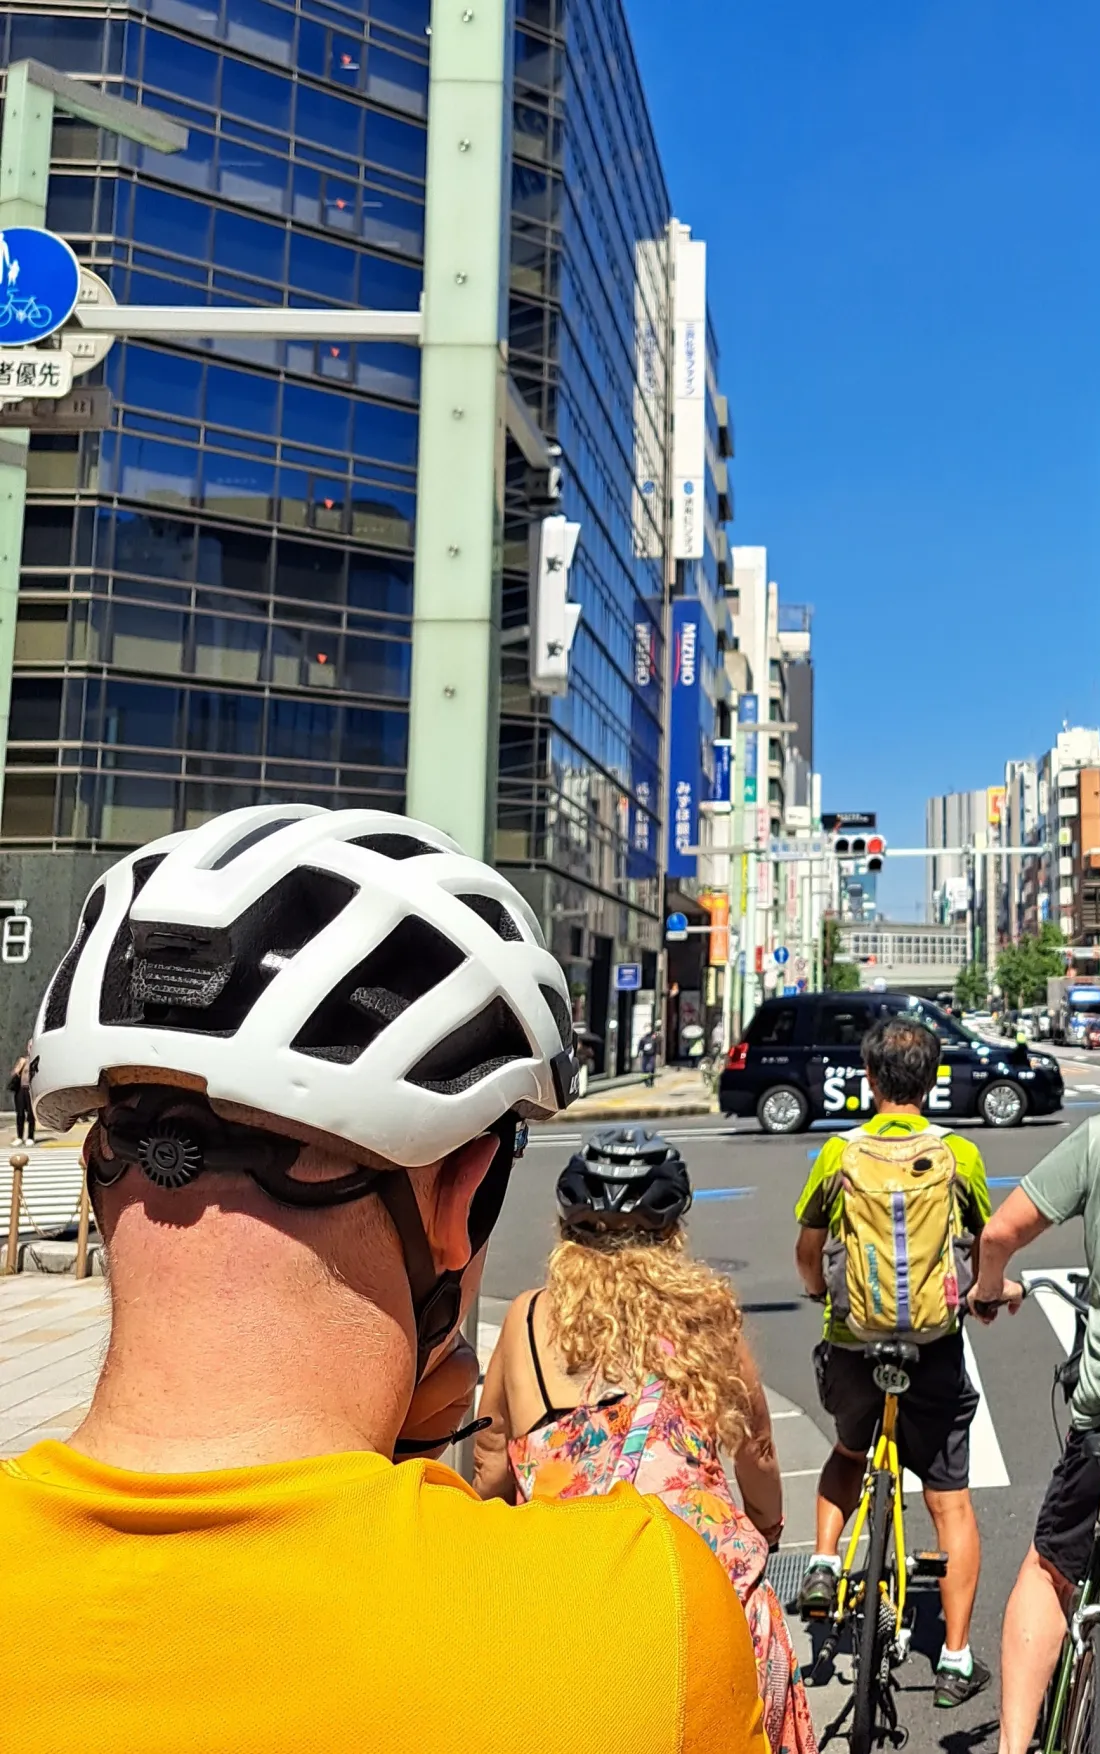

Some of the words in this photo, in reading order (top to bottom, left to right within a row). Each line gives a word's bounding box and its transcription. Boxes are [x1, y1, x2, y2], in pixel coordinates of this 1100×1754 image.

[0, 361, 61, 387] 者優先
[681, 622, 697, 686] MIZUHO
[676, 781, 691, 850] みずほ銀行
